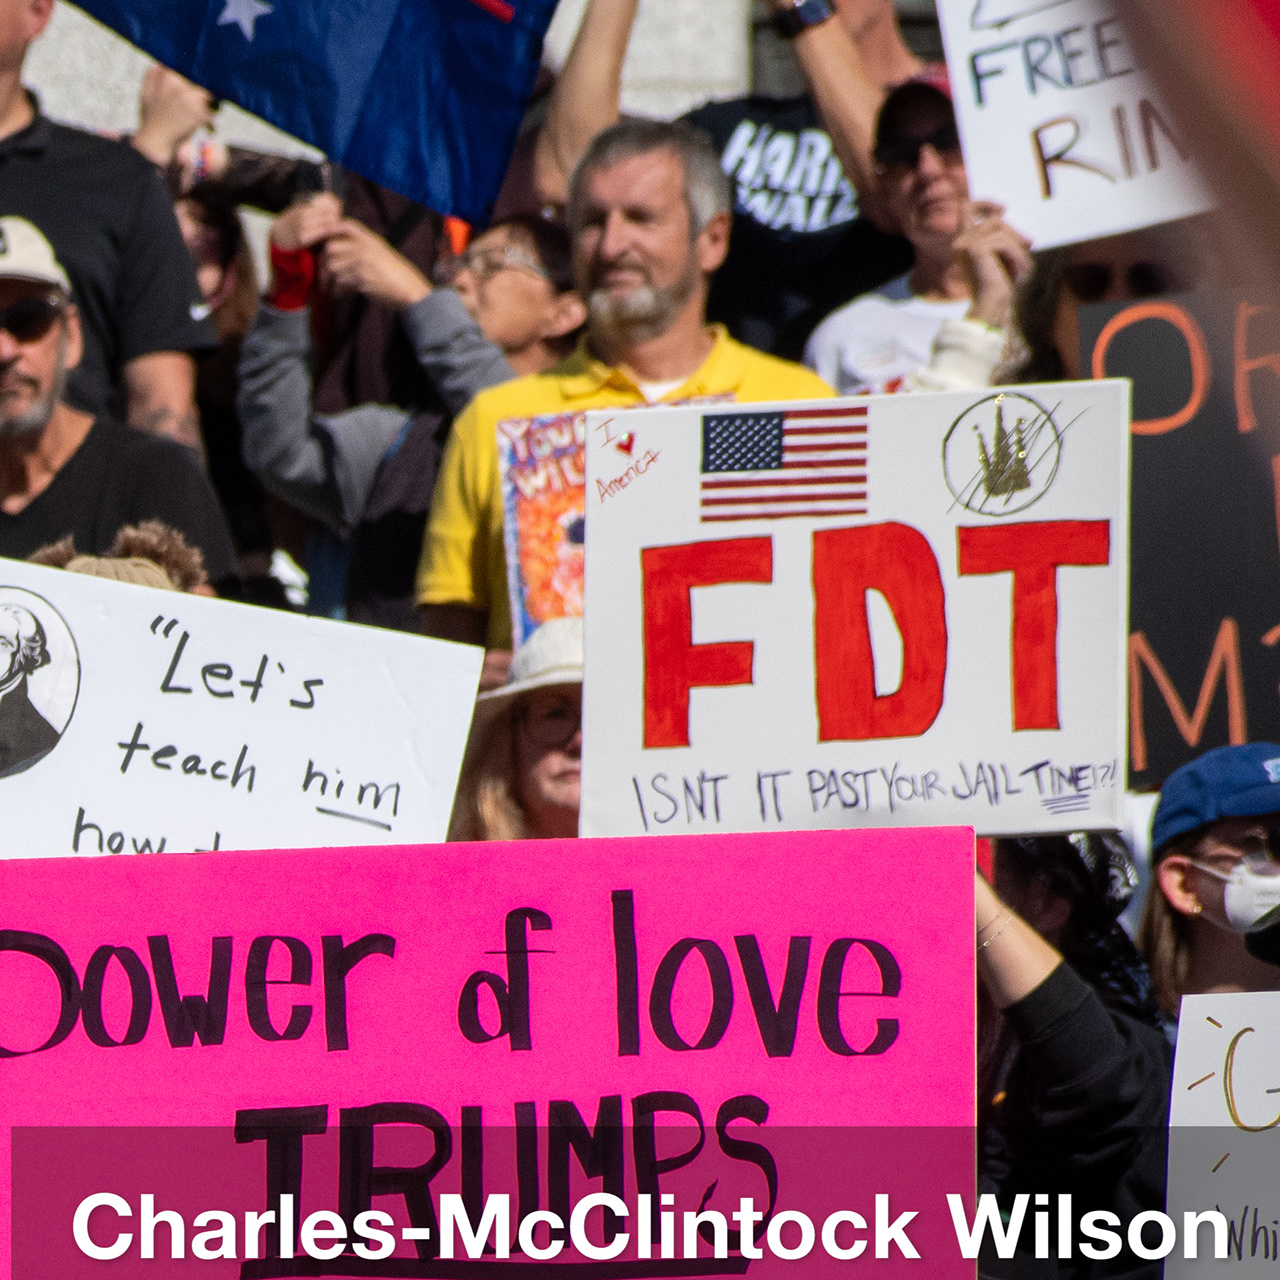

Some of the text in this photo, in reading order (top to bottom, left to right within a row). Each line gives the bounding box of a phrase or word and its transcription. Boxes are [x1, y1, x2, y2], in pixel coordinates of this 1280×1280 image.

[640, 520, 1112, 749] FDT
[71, 806, 168, 855] how
[117, 722, 402, 817] teach him
[756, 770, 792, 823] IT
[808, 767, 878, 814] PAST
[879, 761, 948, 814] YOUR
[951, 761, 1022, 806] JAIL
[610, 888, 903, 1059] love
[235, 1090, 778, 1262] TRUMPS
